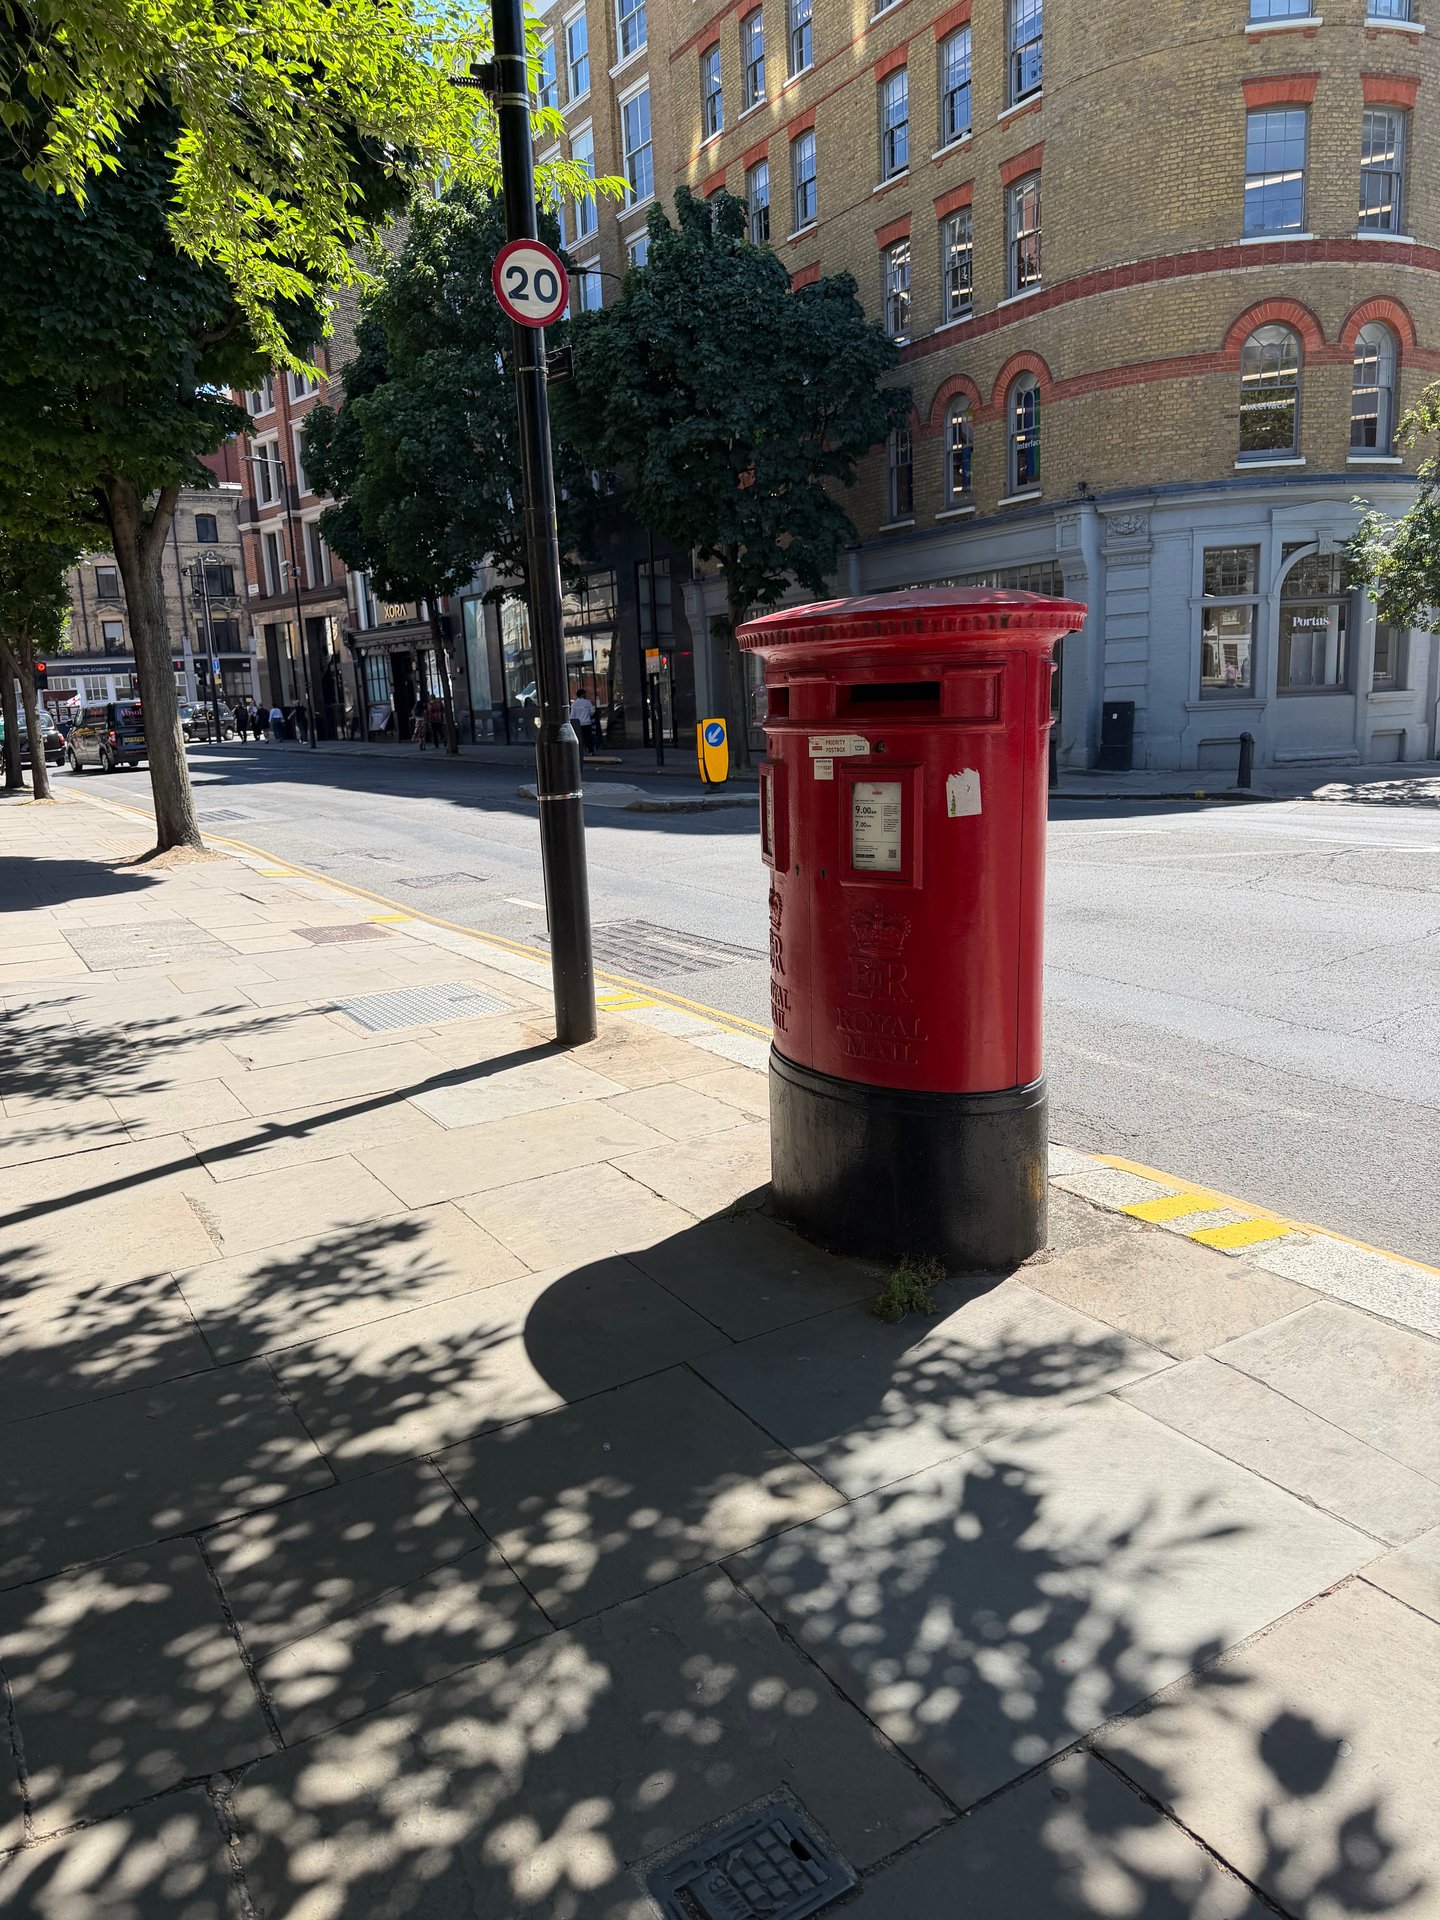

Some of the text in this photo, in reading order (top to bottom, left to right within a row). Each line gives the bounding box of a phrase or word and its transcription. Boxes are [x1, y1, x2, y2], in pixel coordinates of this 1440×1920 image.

[506, 266, 558, 304] 20
[1017, 440, 1040, 450] Interfac
[384, 603, 407, 619] XORA
[836, 1007, 929, 1041] ROYAL
[845, 1034, 919, 1065] MAIL
